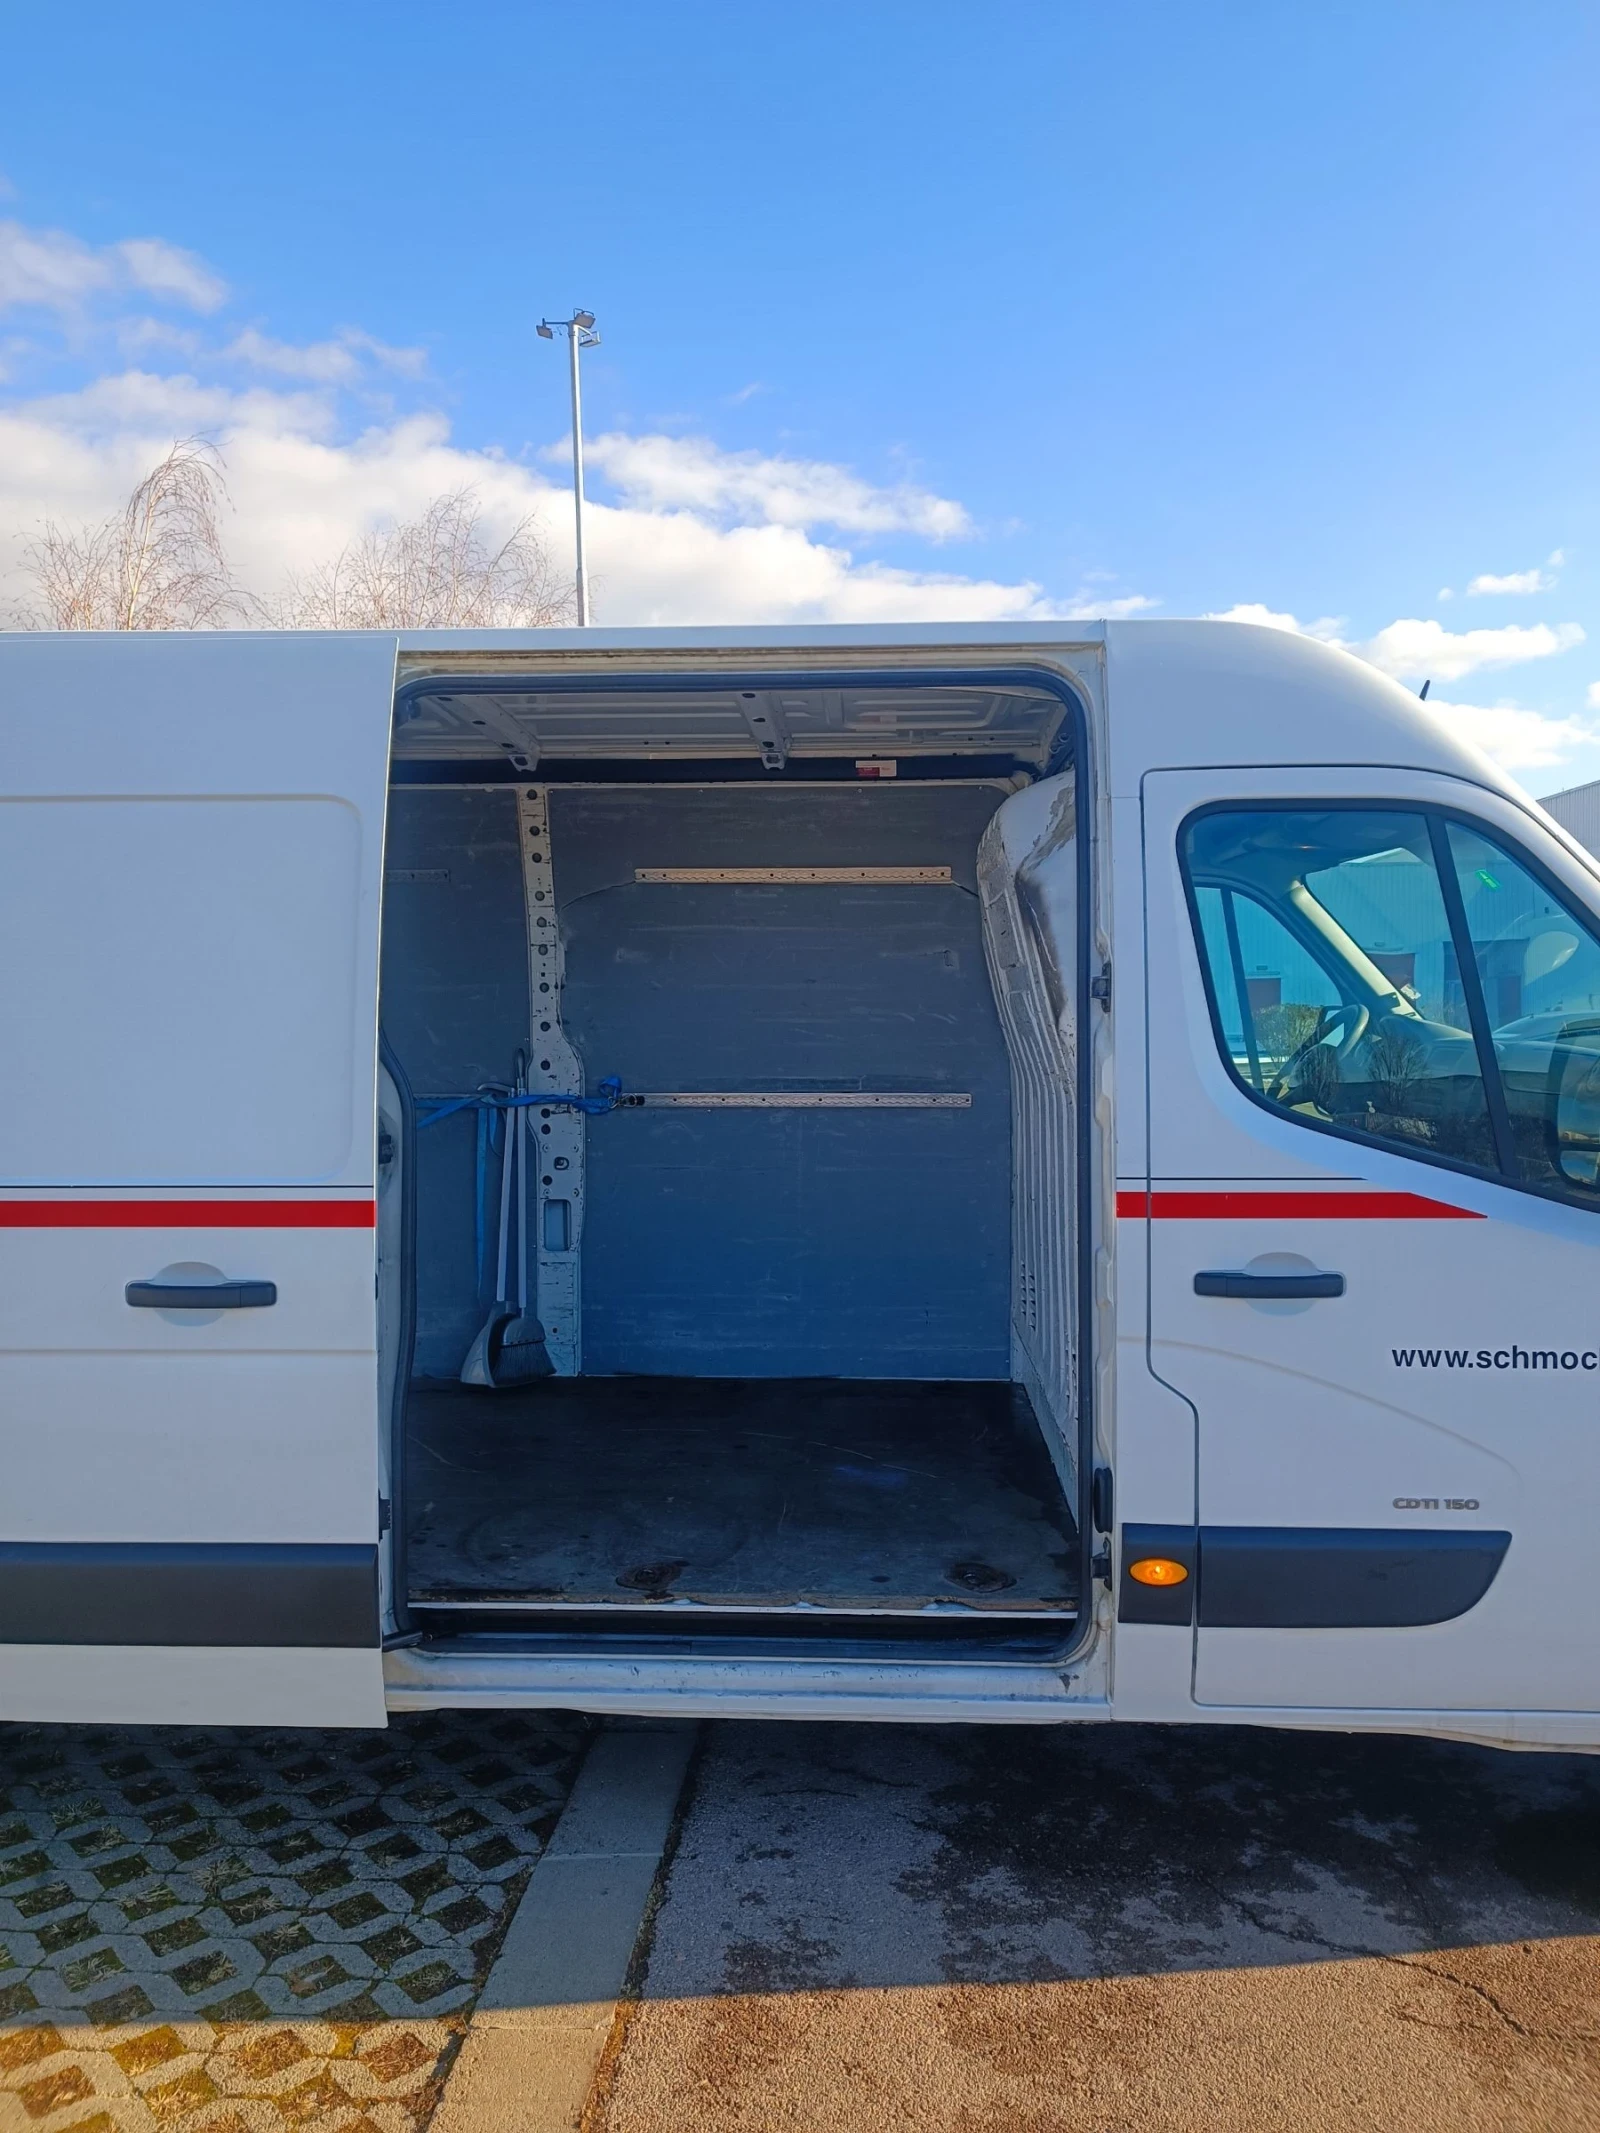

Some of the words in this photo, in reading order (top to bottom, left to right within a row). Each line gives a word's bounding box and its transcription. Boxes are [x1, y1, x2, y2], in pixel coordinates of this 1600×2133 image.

[1392, 1345, 1600, 1370] www.schmoc
[1392, 1497, 1440, 1510] CDTI
[1443, 1498, 1480, 1511] 150
